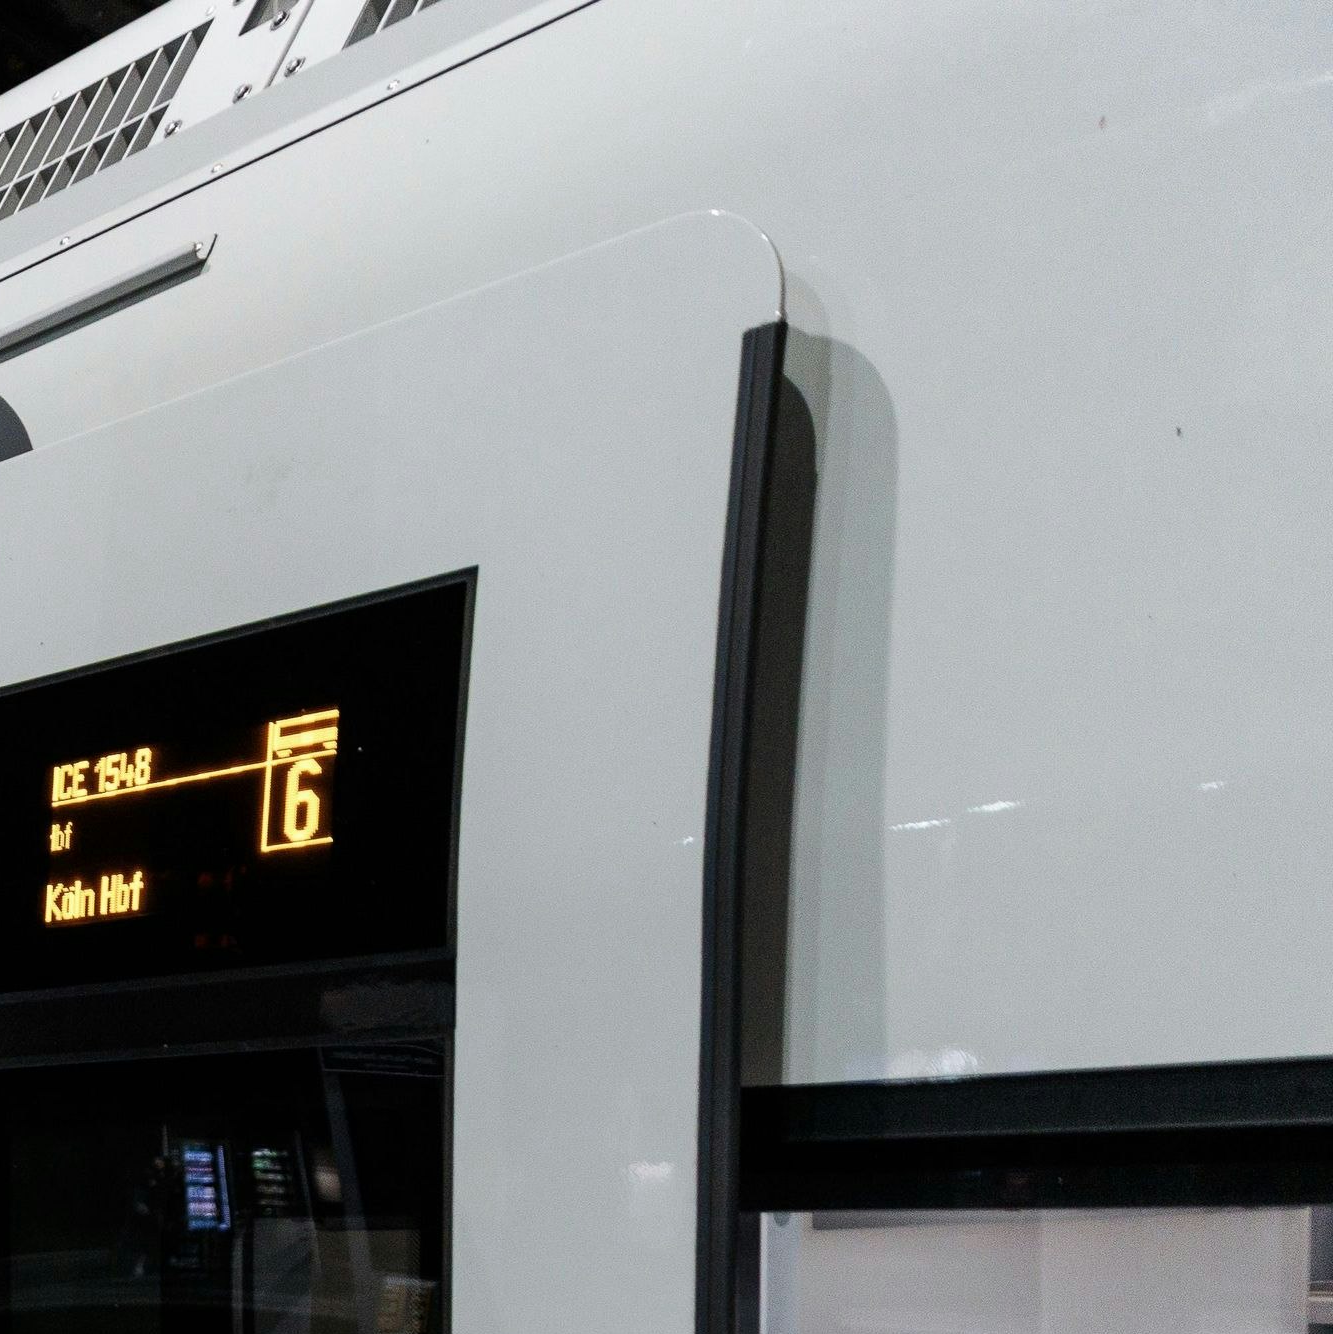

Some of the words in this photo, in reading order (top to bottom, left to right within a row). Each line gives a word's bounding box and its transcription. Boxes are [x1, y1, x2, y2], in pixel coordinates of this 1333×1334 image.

[52, 761, 89, 801] ICE
[94, 747, 152, 793] 1548
[283, 758, 321, 843] 6
[45, 880, 96, 923] Köln
[100, 871, 144, 916] Hbf
